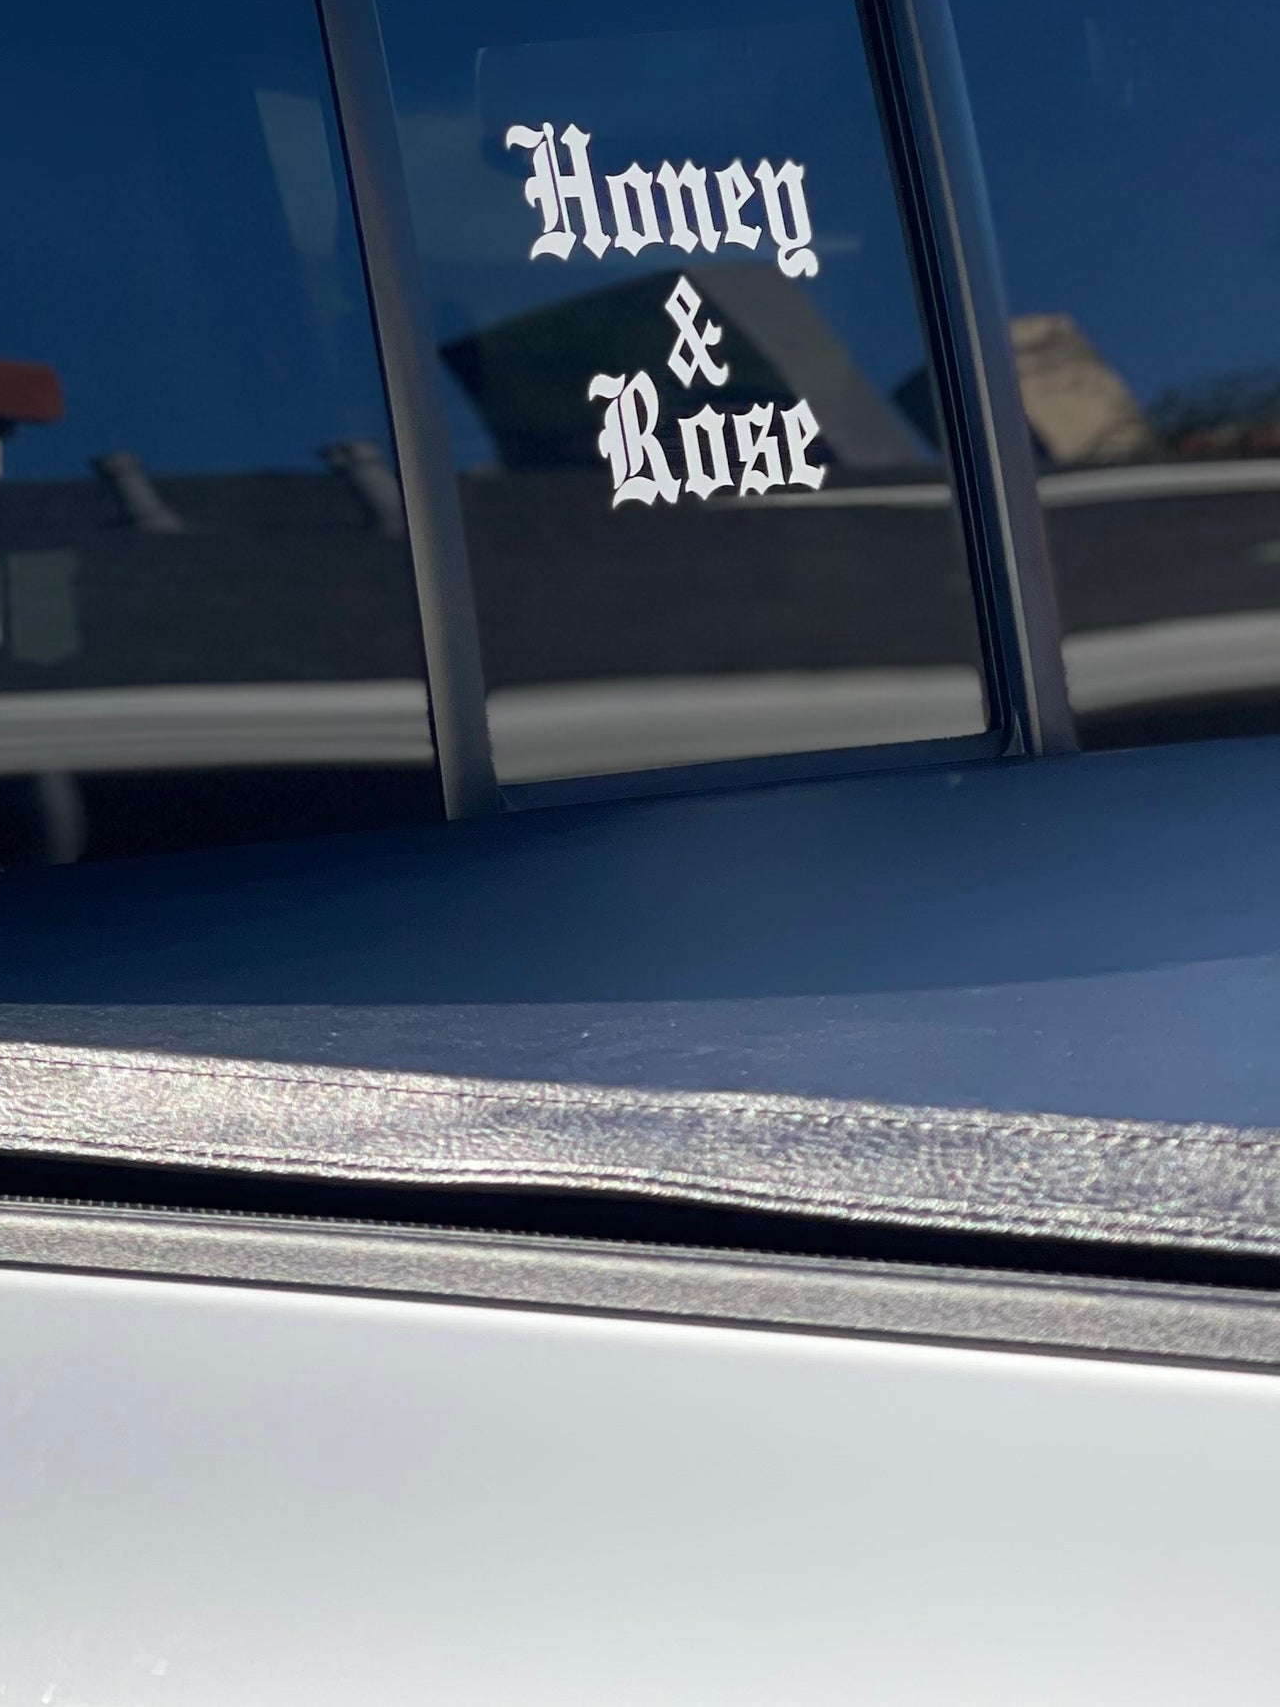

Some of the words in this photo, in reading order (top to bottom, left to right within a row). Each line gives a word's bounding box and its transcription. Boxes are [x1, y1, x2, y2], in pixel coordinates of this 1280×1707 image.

[505, 122, 819, 278] Honey
[664, 275, 729, 388] &
[588, 370, 826, 509] Rose
